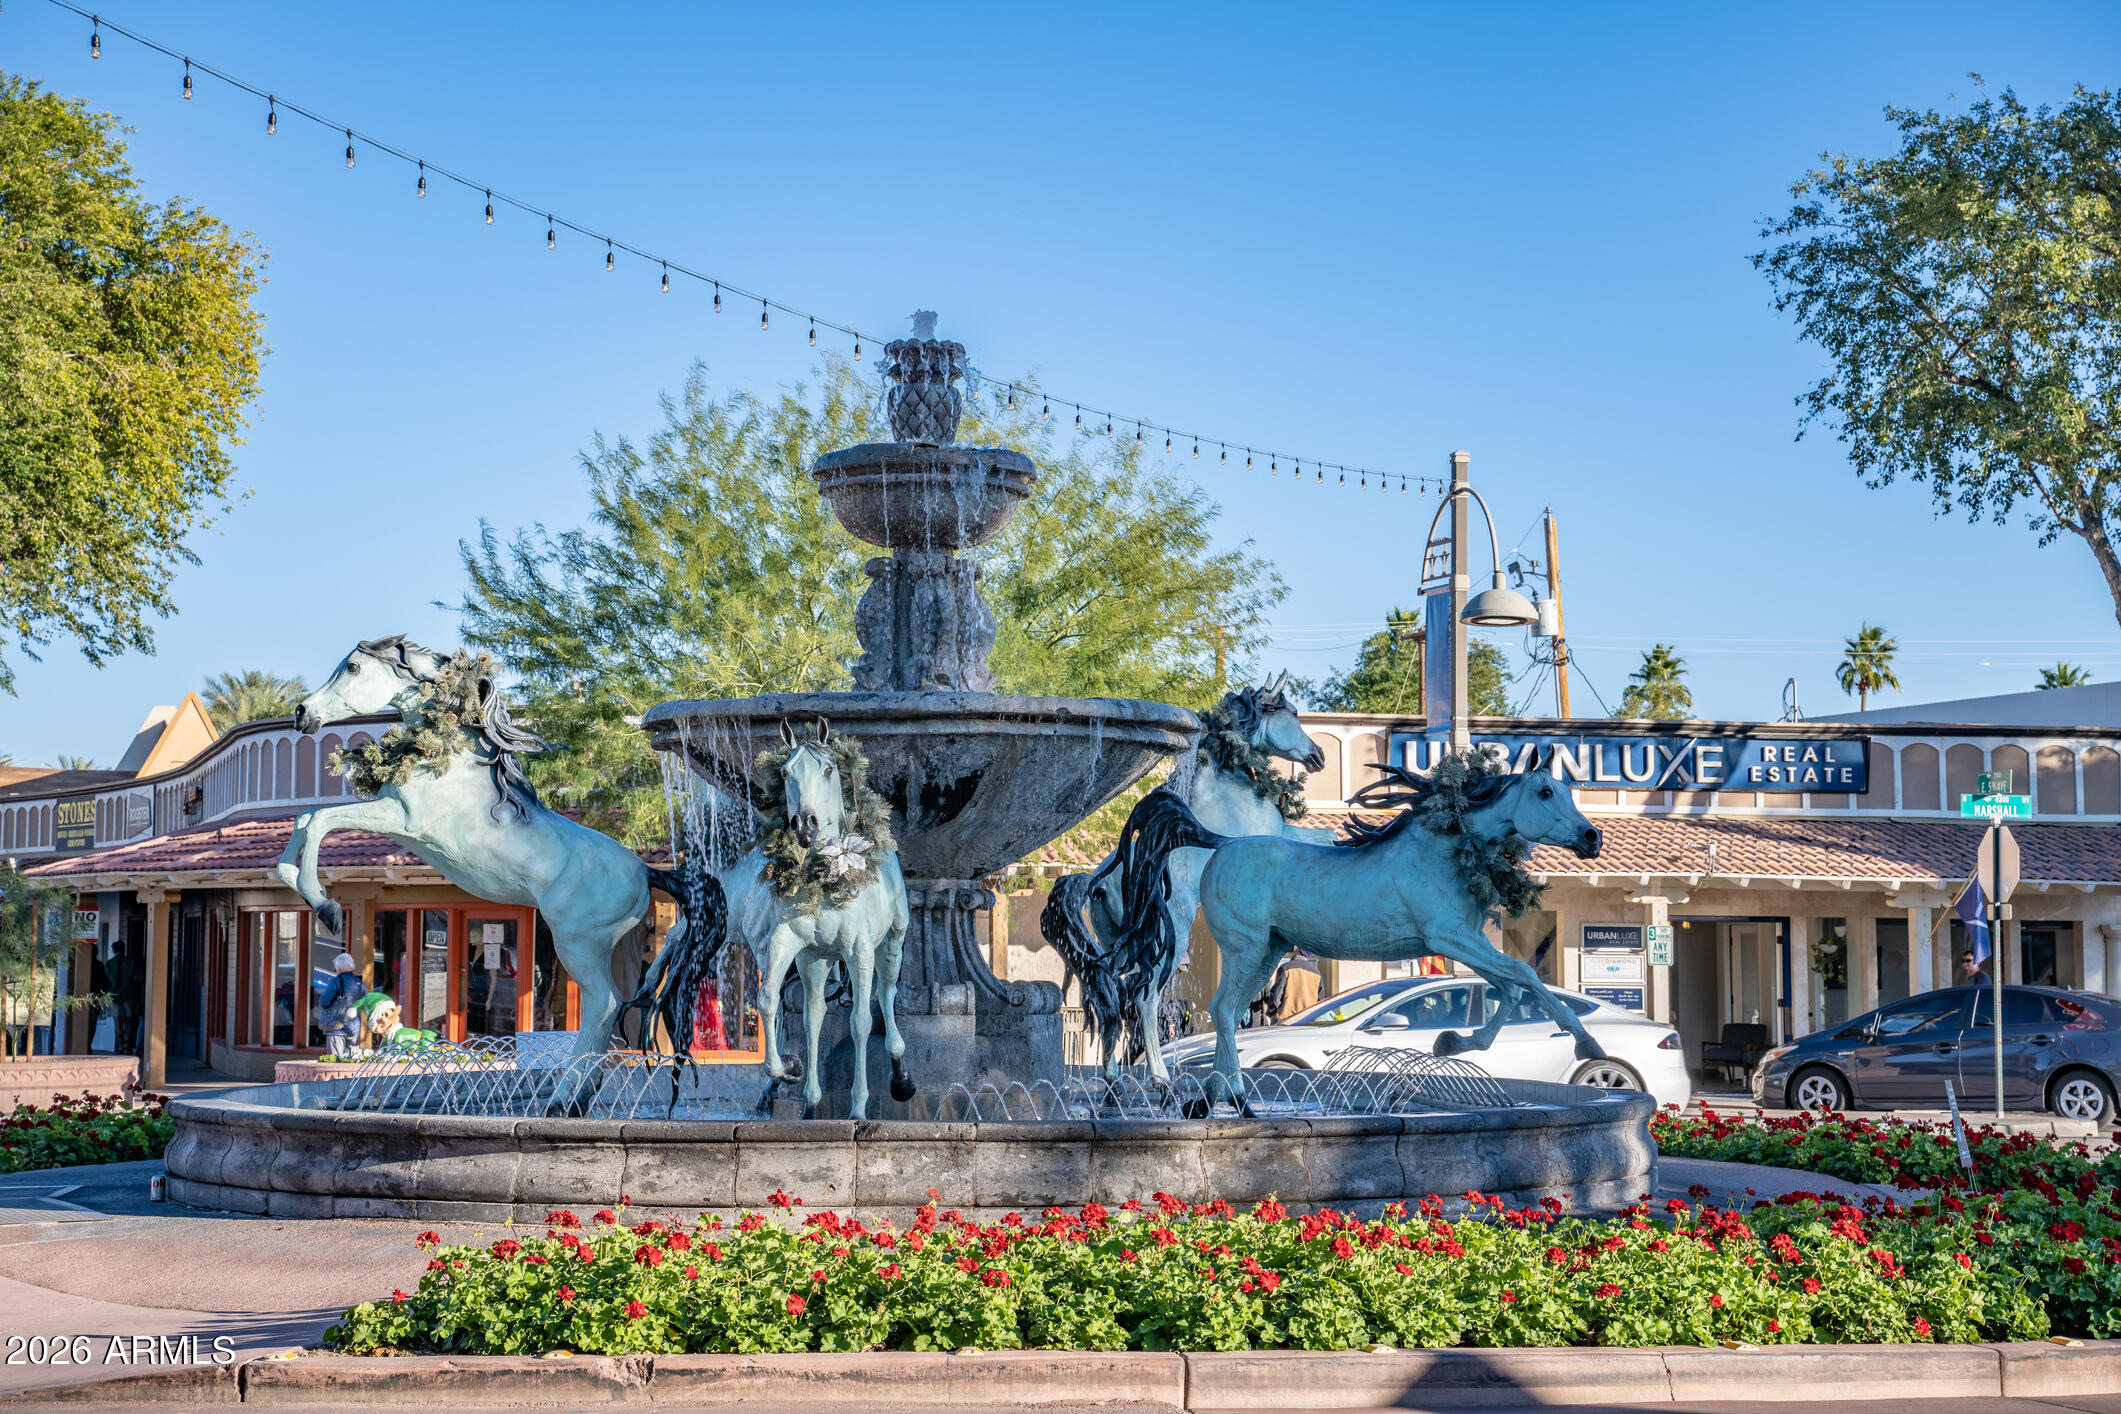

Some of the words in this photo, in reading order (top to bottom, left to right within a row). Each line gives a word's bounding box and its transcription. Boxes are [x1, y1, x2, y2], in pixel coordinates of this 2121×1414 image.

[1763, 745, 1836, 763] REAL
[1750, 766, 1853, 783] ESTATE
[58, 800, 96, 824] STONES
[1974, 805, 2019, 817] MARSHALL
[74, 912, 97, 922] NO
[428, 931, 445, 944] OPEN
[1587, 932, 1639, 940] URBANLUXE
[1649, 927, 1655, 940] 3
[1653, 942, 1668, 952] ANY
[1653, 953, 1668, 963] TIME
